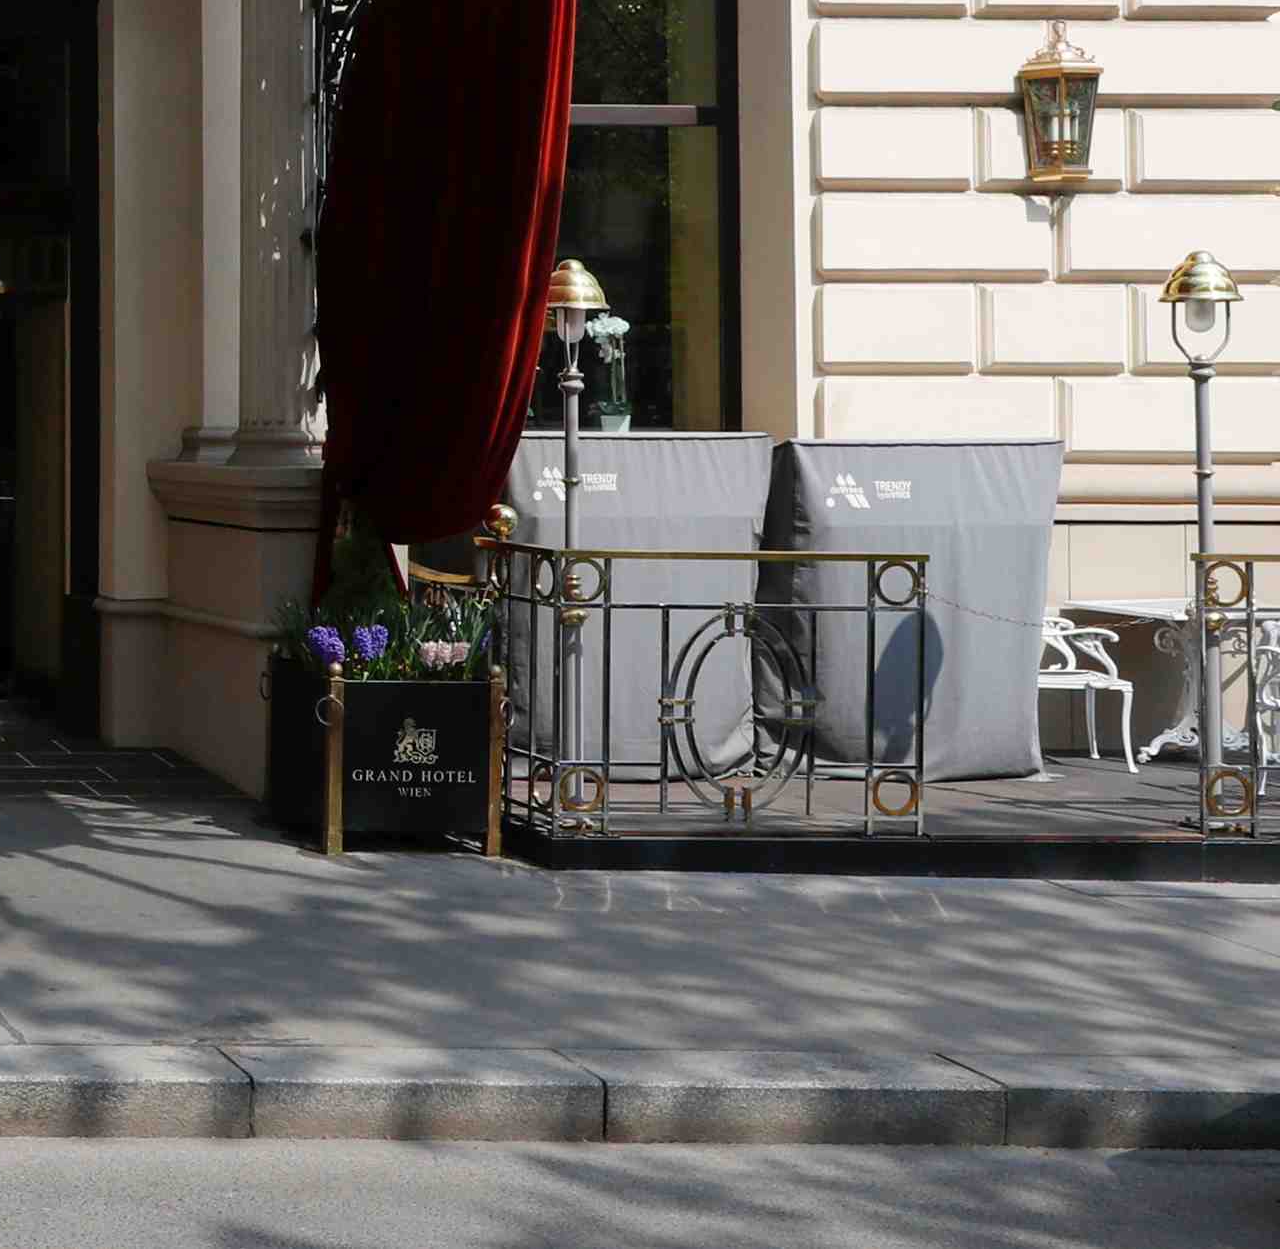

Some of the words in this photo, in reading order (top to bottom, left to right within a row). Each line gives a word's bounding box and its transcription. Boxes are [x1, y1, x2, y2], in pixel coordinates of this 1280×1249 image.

[352, 769, 413, 782] GRAND
[421, 769, 477, 784] HOTEL
[397, 786, 432, 798] WIEN
